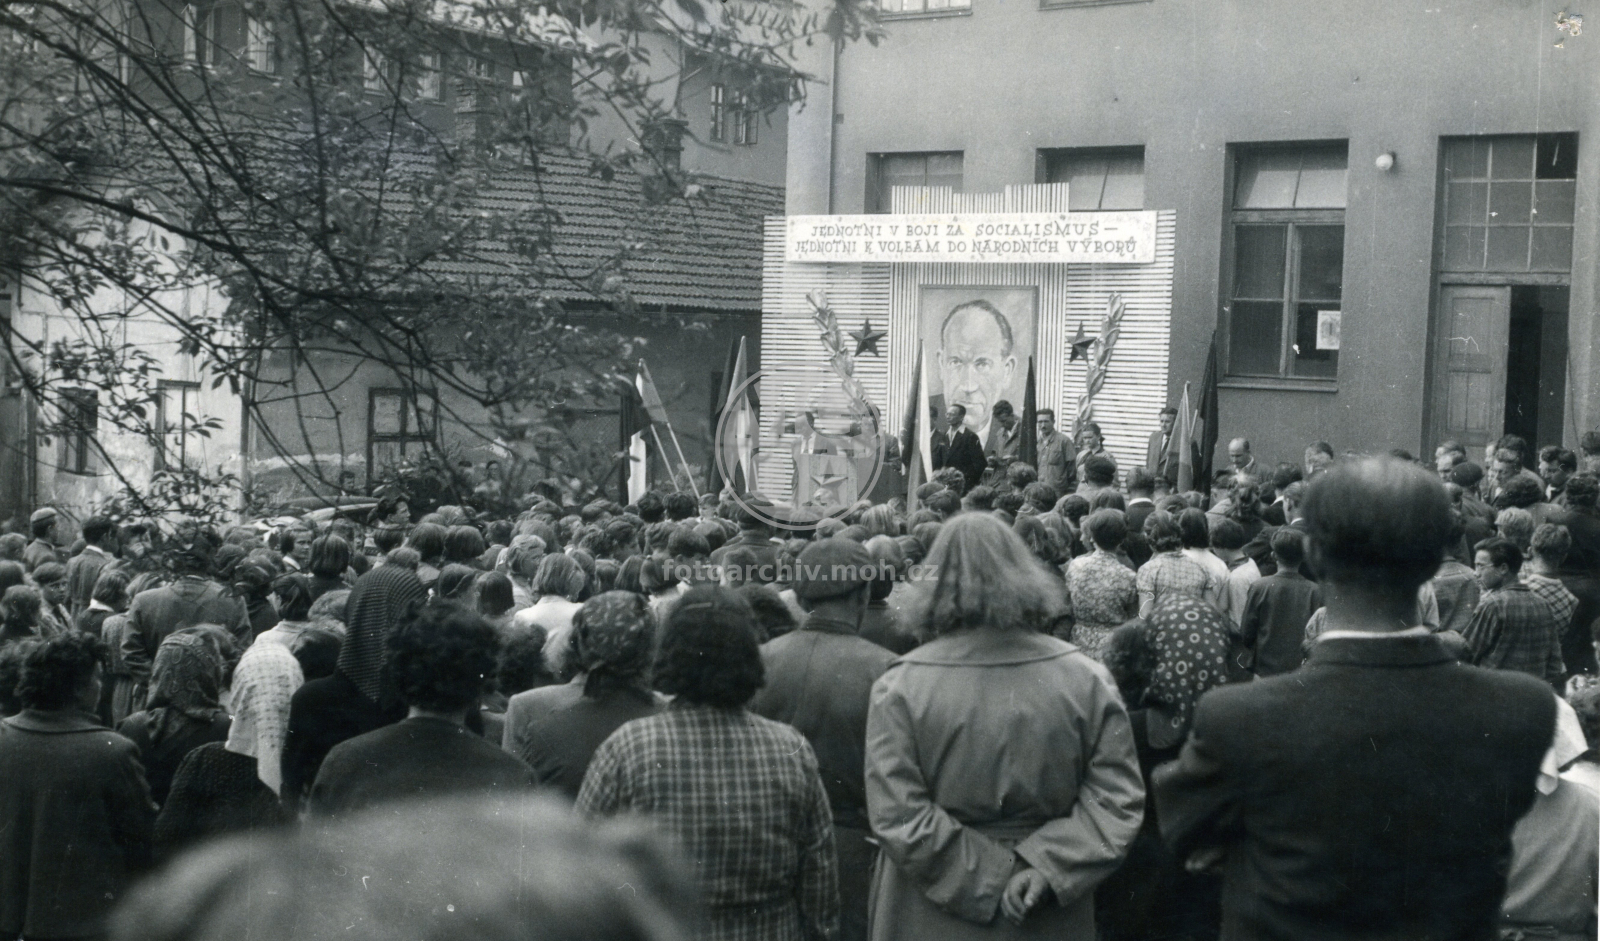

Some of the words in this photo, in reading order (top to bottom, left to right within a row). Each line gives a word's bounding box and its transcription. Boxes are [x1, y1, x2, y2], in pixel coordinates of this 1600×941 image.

[811, 224, 882, 238] JEDNOTNI
[889, 225, 899, 237] V
[906, 224, 938, 237] BOJI
[946, 224, 965, 237] ZA
[975, 221, 1100, 237] SOCIALISMUS
[794, 239, 857, 254] JEDNOTNI
[864, 240, 874, 254] K
[947, 240, 967, 253] DO
[971, 238, 1060, 256] NÁRODNÍCH
